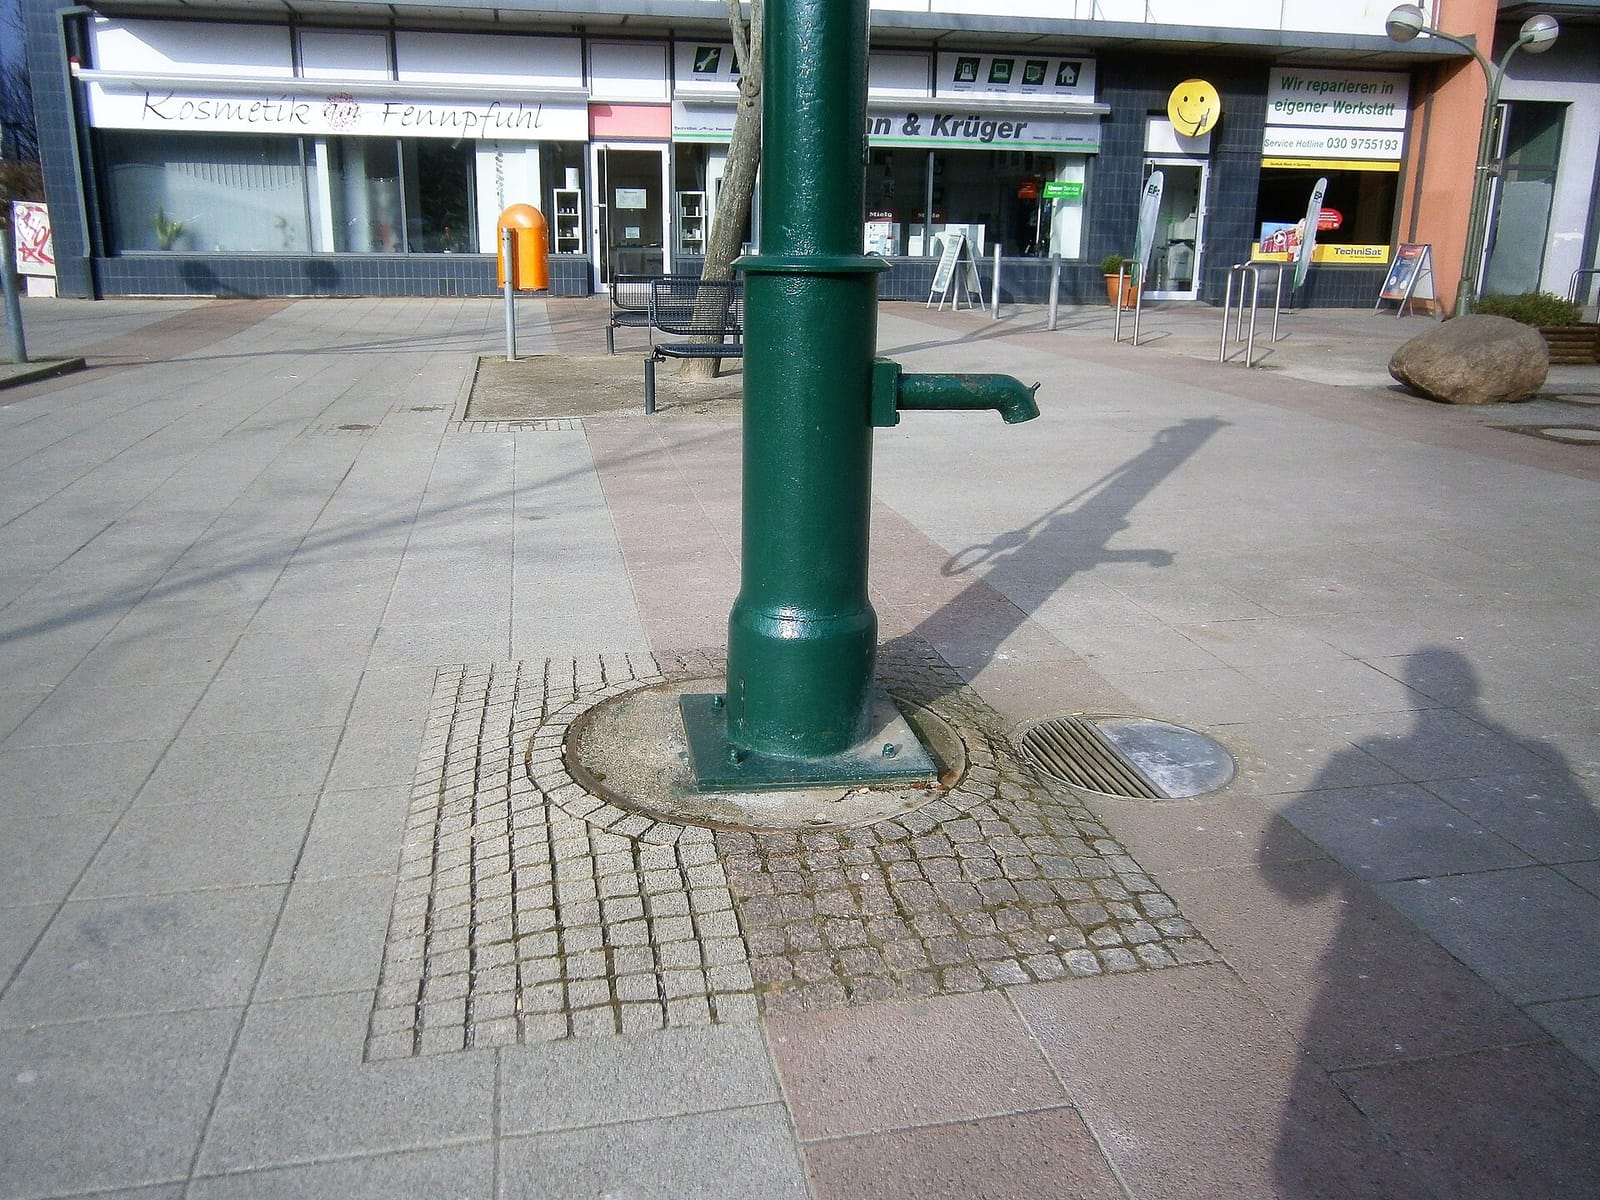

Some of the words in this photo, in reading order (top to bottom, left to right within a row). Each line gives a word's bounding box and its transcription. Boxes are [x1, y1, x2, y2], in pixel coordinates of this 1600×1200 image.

[1281, 76, 1304, 90] Wir
[1306, 79, 1377, 95] reparieren
[1380, 81, 1395, 95] in
[143, 91, 310, 125] Kosmetik
[382, 101, 545, 140] Fennpfuhl
[1274, 98, 1328, 115] eigener
[1332, 100, 1395, 116] Werkstatt
[902, 112, 922, 136] &
[930, 113, 1029, 143] Krüger
[1263, 138, 1294, 148] Service
[1295, 139, 1325, 149] Hotline
[1326, 137, 1348, 149] 030
[1350, 137, 1399, 151] 9755193
[1333, 247, 1383, 256] TechniSat
